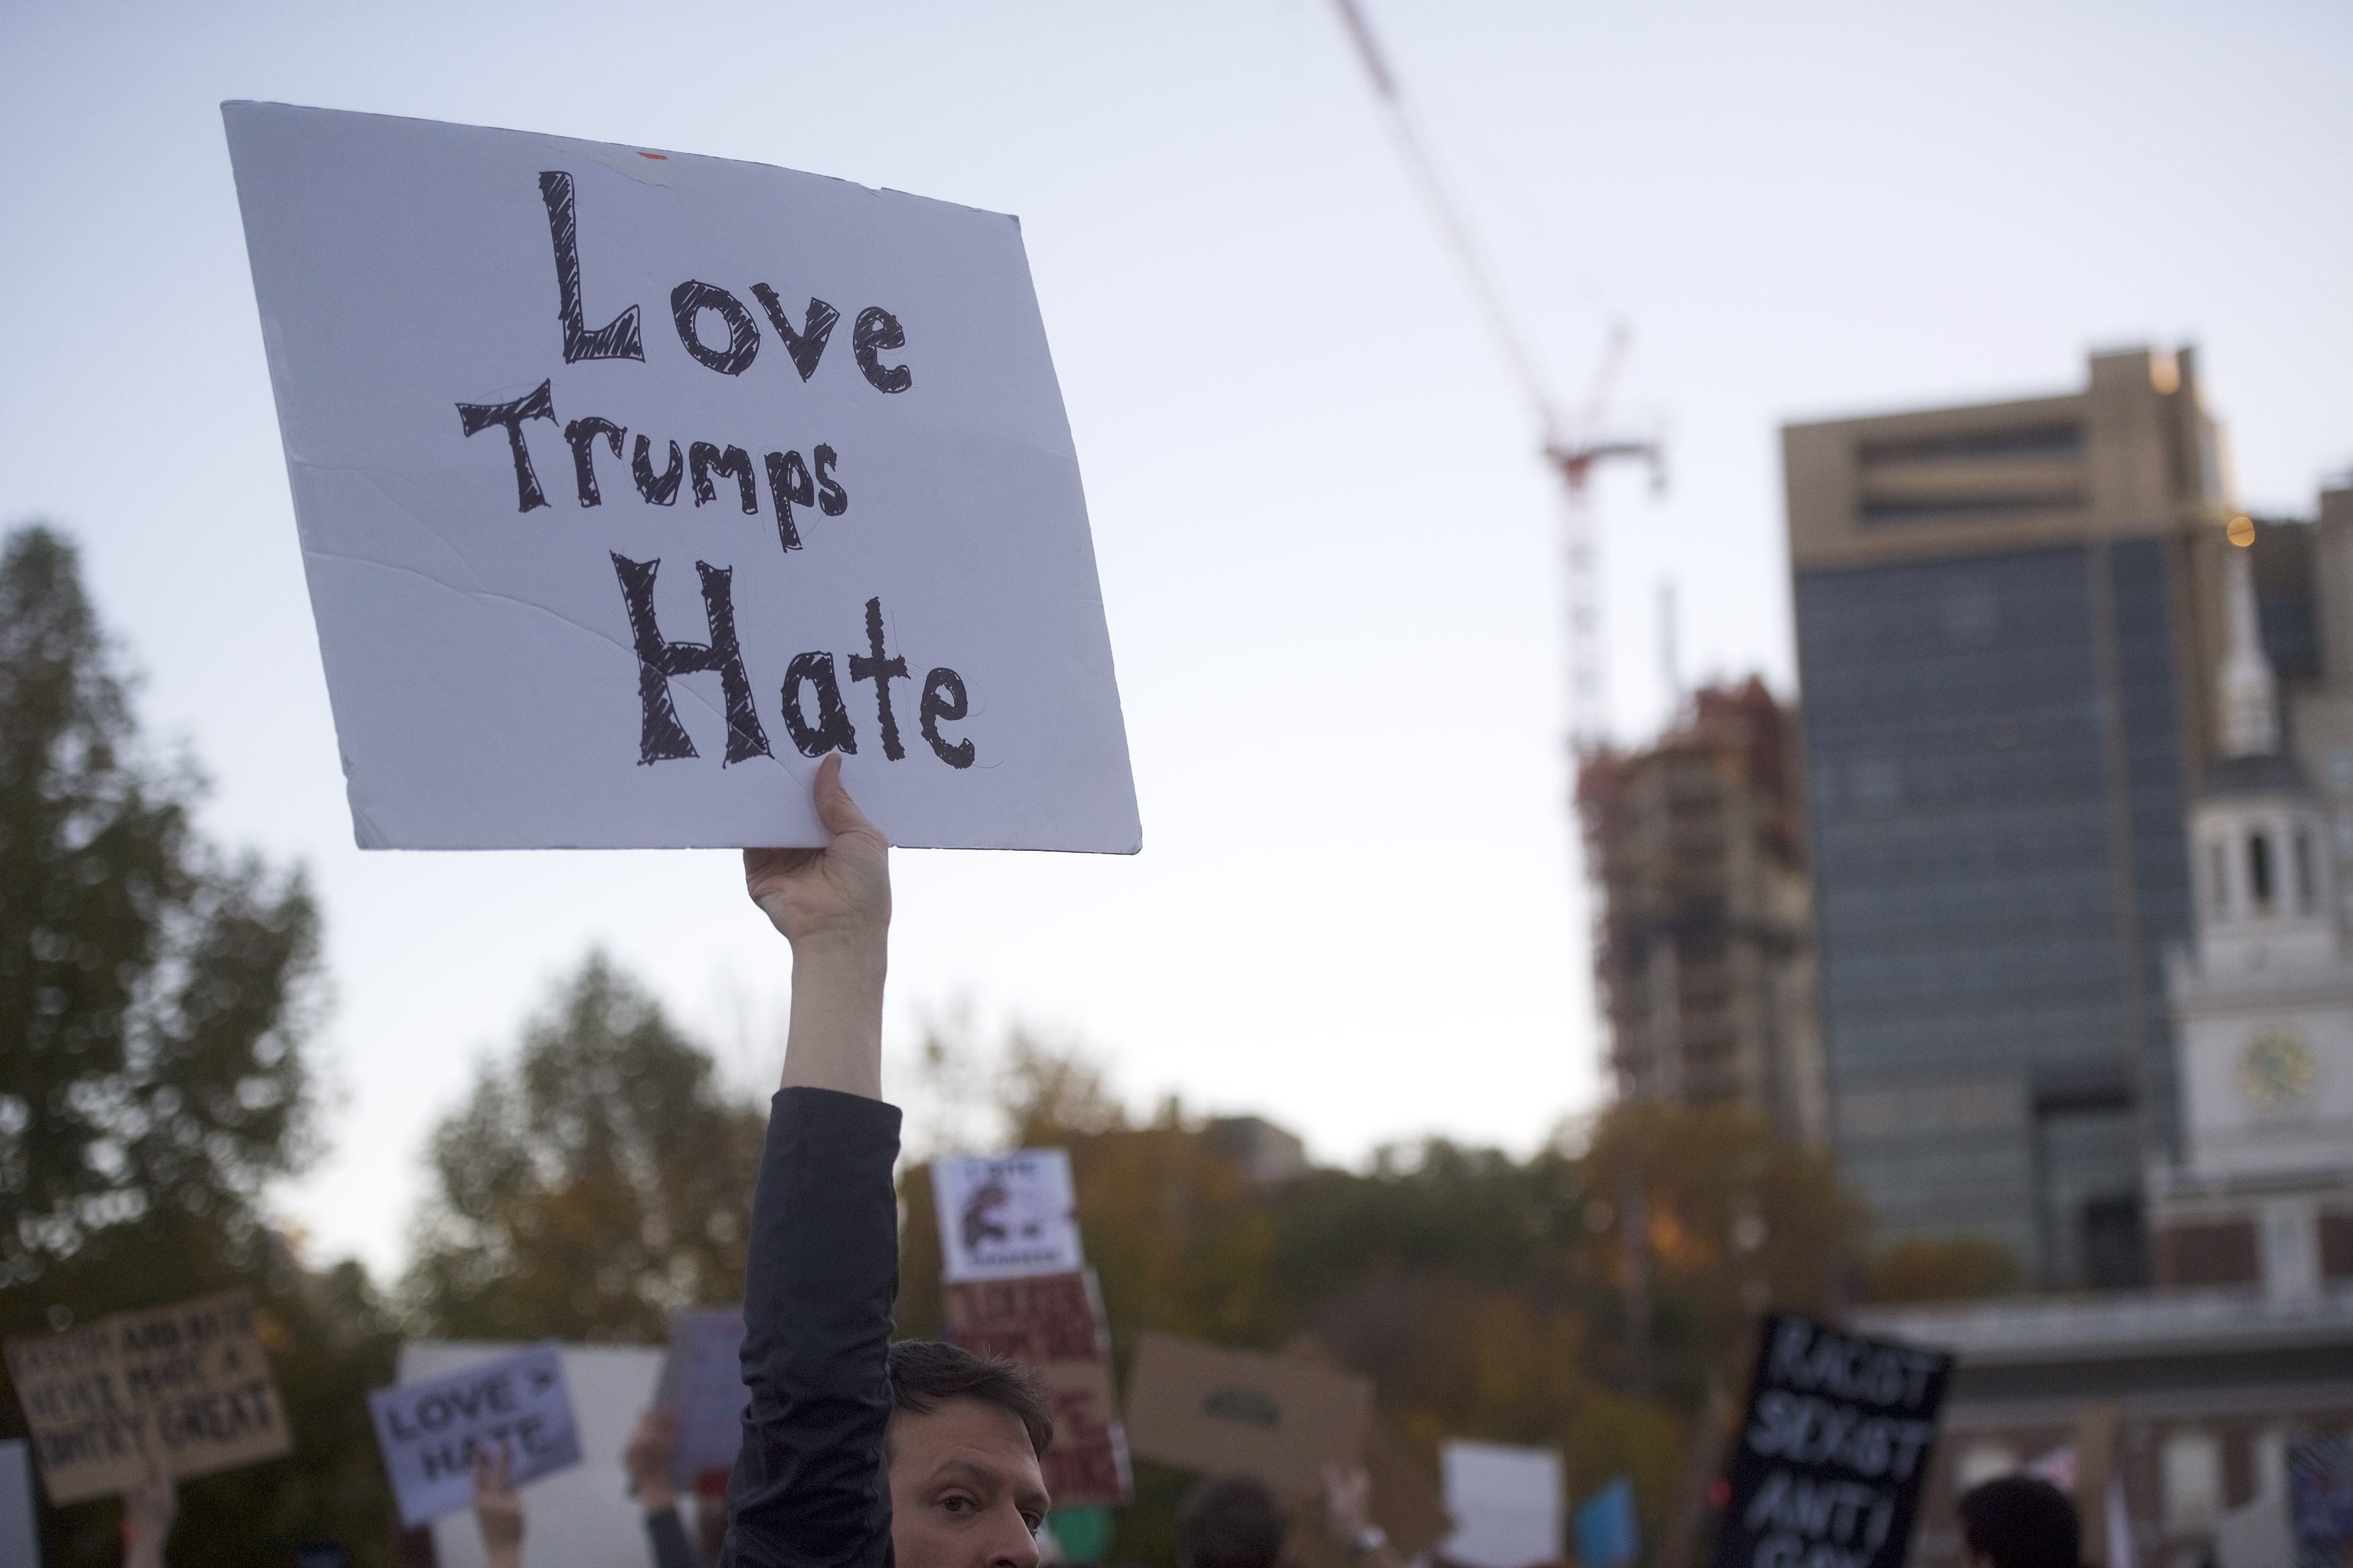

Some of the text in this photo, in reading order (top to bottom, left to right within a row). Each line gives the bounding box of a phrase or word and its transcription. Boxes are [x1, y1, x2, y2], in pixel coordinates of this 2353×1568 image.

[538, 171, 912, 395] Love
[454, 378, 848, 554] Trumps
[609, 550, 975, 770] Hate
[387, 1368, 516, 1442] LOVE
